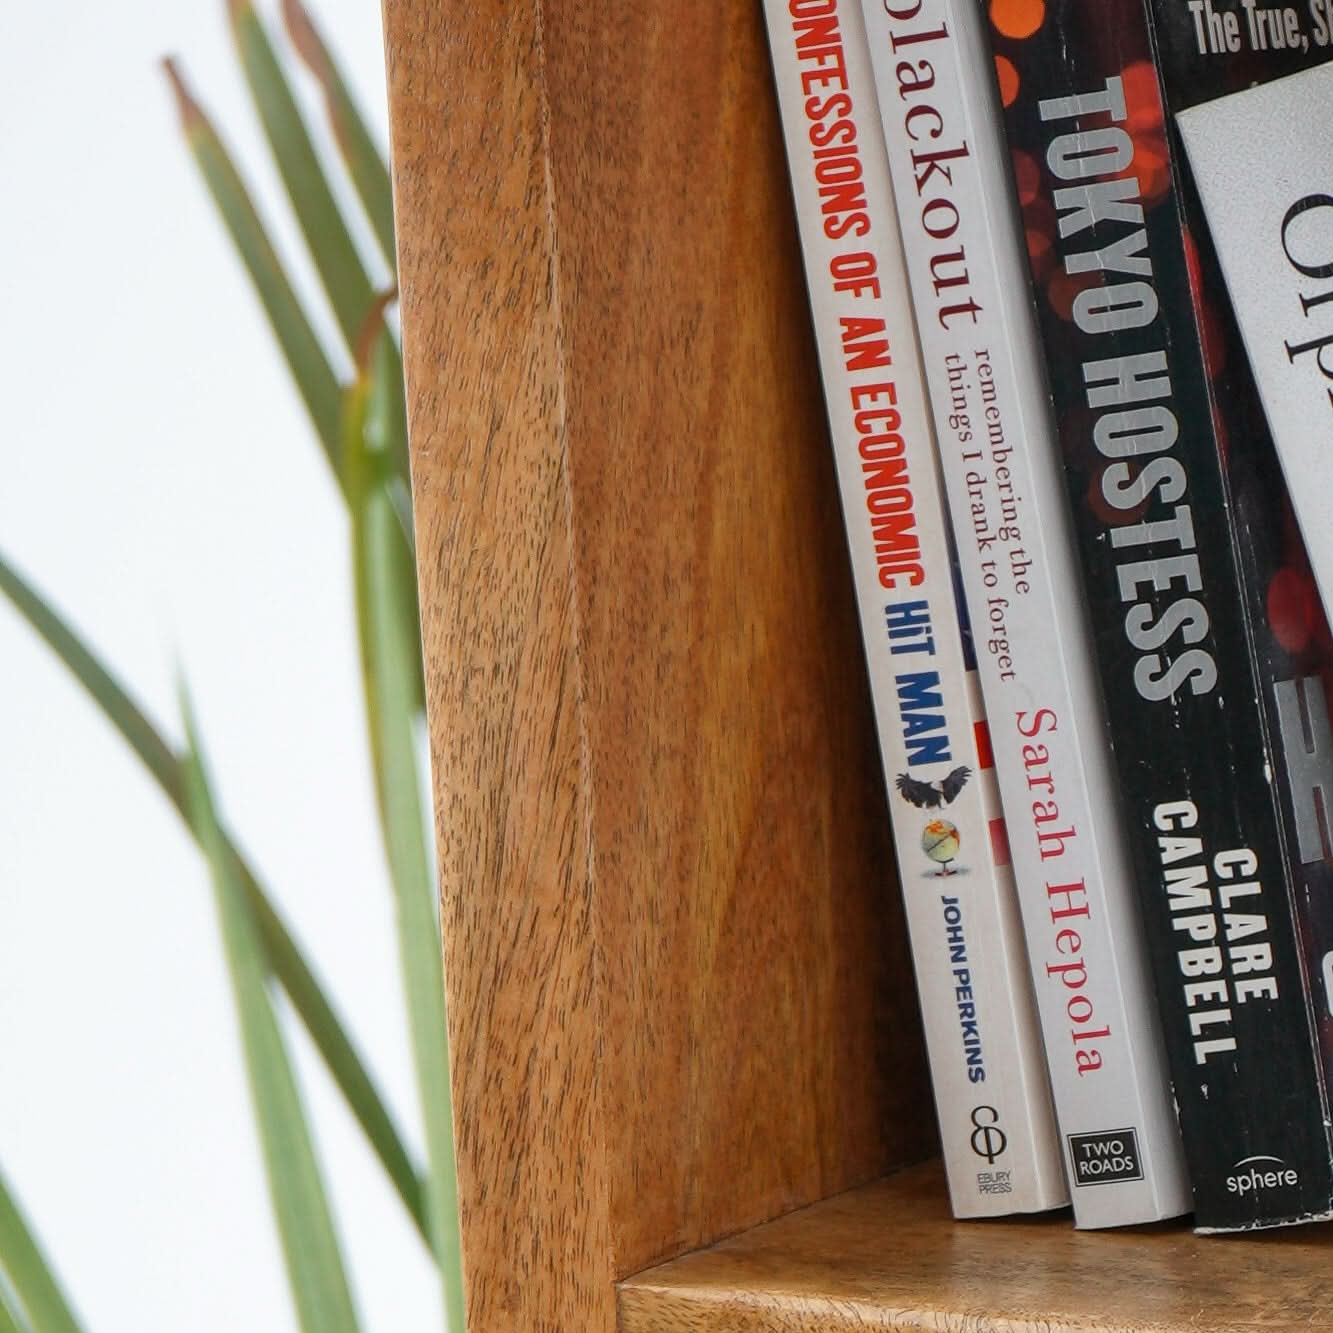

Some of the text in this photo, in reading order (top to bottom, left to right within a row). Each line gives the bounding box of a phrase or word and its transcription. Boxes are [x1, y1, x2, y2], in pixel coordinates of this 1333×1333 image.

[1189, 0, 1241, 54] The
[1244, 0, 1309, 53] True,
[788, 0, 872, 241] ONFESSIONS
[829, 251, 881, 300] OF
[839, 316, 892, 371] AN
[1038, 76, 1219, 702] TOKYO HOSTESS
[850, 381, 925, 589] ECONOMIC
[944, 352, 1017, 683] things I drank to forget
[974, 348, 1031, 596] remembering the
[895, 670, 952, 766] MAN
[1015, 708, 1112, 1077] Sarah Hepola
[1152, 799, 1237, 1066] CAMPBELL
[1213, 849, 1279, 1003] CLARE
[941, 895, 984, 1084] JOHN PERKINS
[977, 1172, 1011, 1184] EBURY
[979, 1182, 1012, 1194] PRESS
[1079, 1156, 1134, 1175] ROADS
[1081, 1142, 1123, 1158] TWO
[1227, 1167, 1298, 1193] sphere
